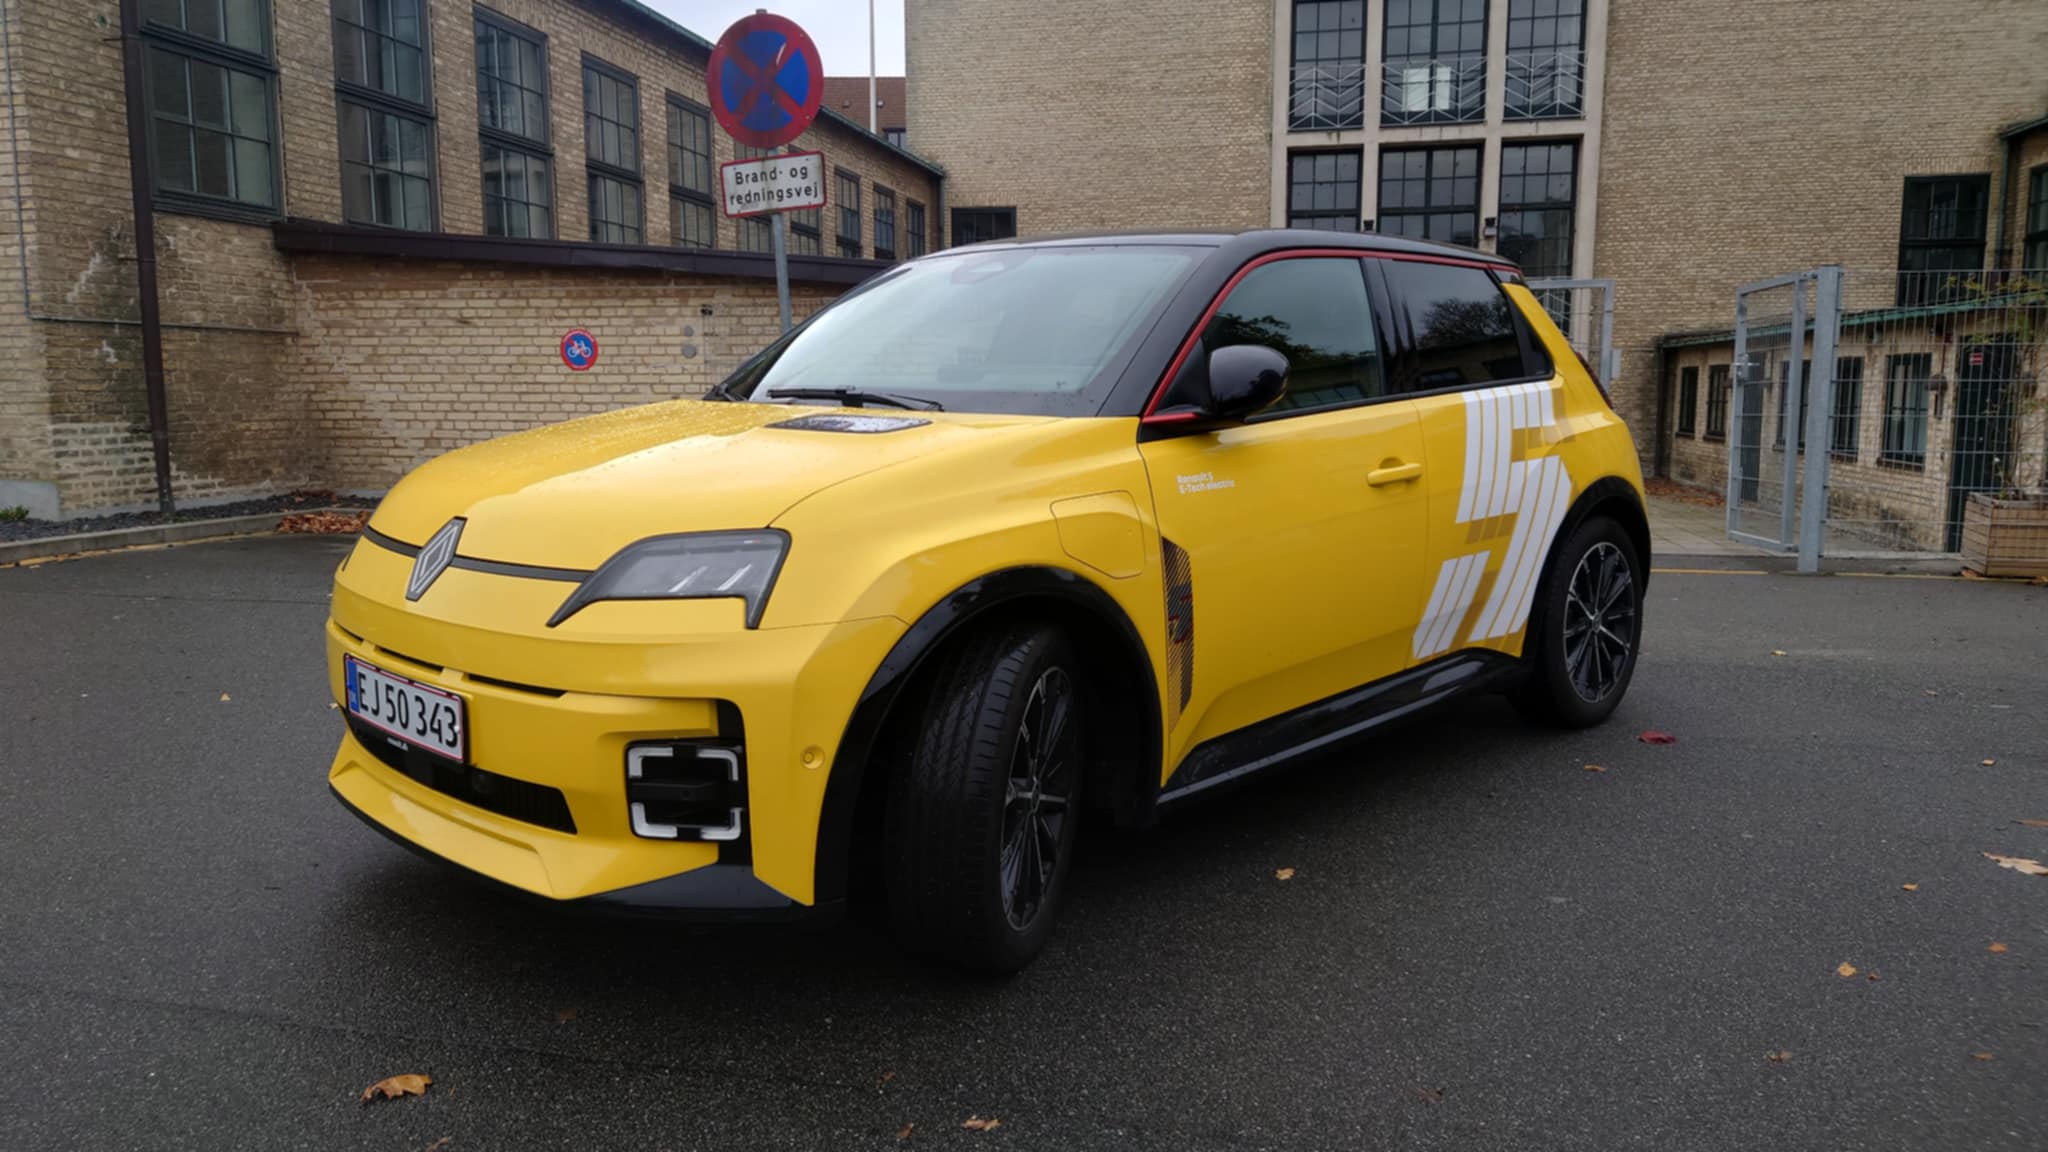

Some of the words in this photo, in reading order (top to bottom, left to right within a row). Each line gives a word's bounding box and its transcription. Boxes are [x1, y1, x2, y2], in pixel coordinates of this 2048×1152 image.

[735, 167, 783, 185] Brand-
[790, 166, 808, 179] og
[730, 182, 818, 205] redningsvej
[358, 672, 380, 716] EJ
[385, 684, 409, 729] 50
[414, 695, 458, 748] 343
